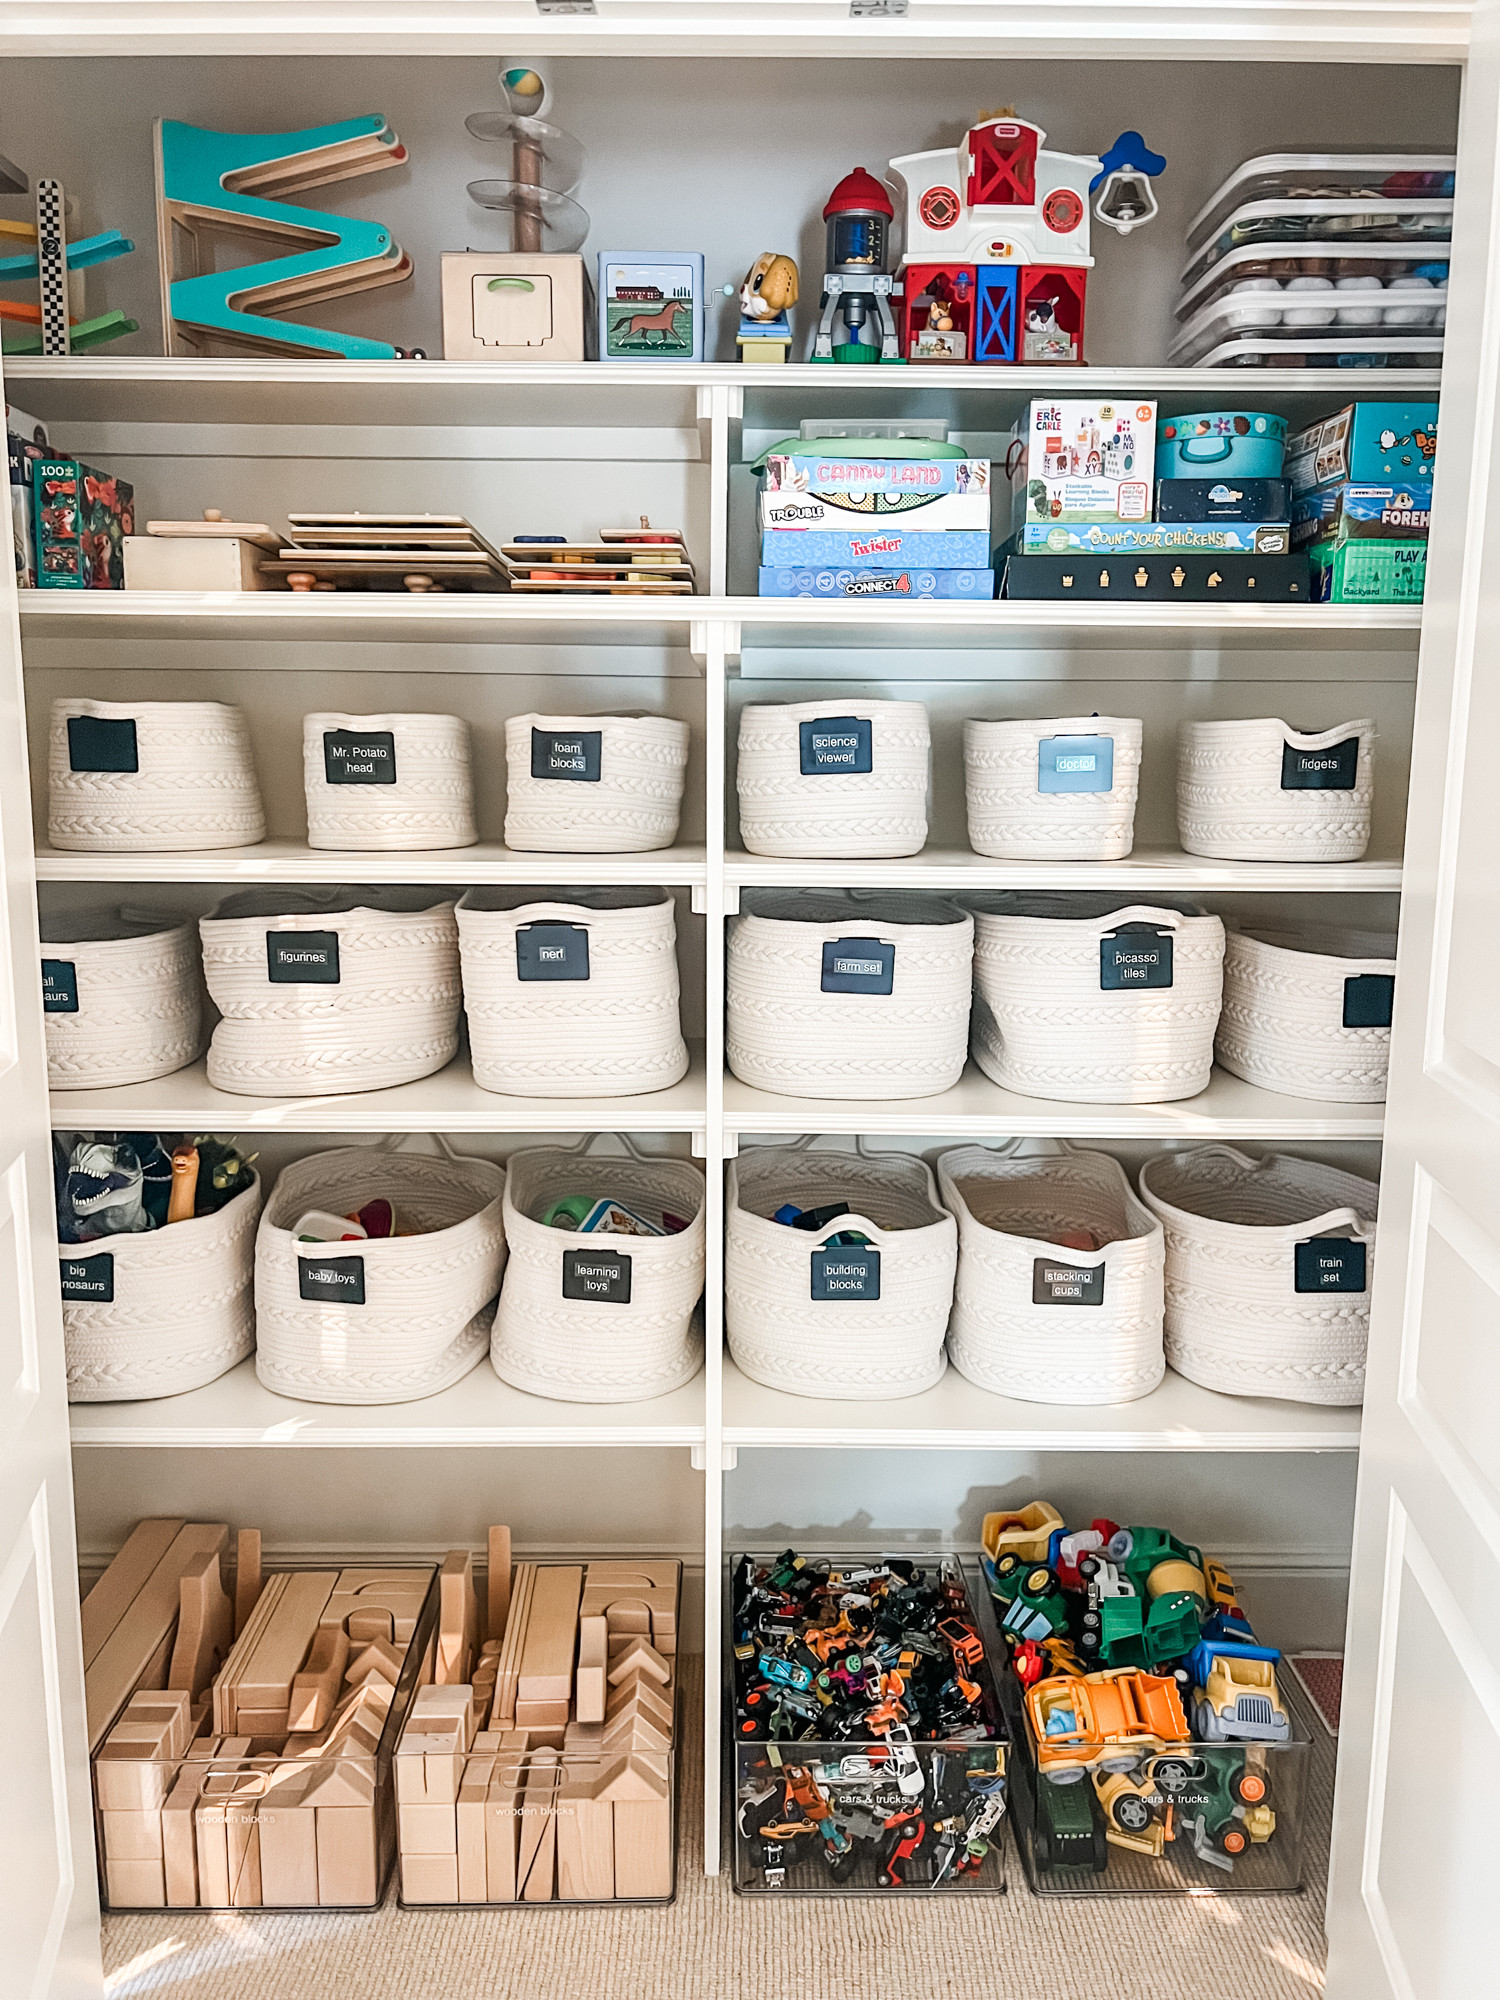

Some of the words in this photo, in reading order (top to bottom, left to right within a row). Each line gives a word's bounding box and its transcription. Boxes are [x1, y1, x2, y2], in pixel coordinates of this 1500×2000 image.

[1037, 411, 1062, 421] ERIC
[1036, 421, 1062, 431] CARLE
[41, 466, 65, 476] 100
[817, 464, 885, 482] CANDY
[891, 465, 942, 485] LAND
[769, 504, 825, 521] TROUBLE
[1090, 530, 1129, 546] COUNT
[1131, 531, 1162, 548] YOUR
[1164, 530, 1227, 547] CHICKENS!
[850, 538, 902, 556] Twister
[1394, 550, 1420, 563] PLAY
[1344, 587, 1380, 597] Backyard
[815, 735, 858, 748] science
[332, 746, 350, 758] Mr.
[352, 746, 388, 758] Potato
[554, 742, 581, 754] foam
[550, 757, 585, 769] blocks
[818, 752, 854, 763] viewer
[1059, 758, 1095, 769] doctor
[346, 762, 374, 773] head
[1301, 758, 1338, 771] fidgets
[279, 950, 326, 963] figurines
[542, 948, 564, 959] nerf
[1115, 952, 1158, 965] picasso
[836, 960, 861, 972] farm
[863, 963, 881, 973] set
[1123, 967, 1146, 979] tiles
[1319, 1256, 1343, 1268] train
[69, 1264, 87, 1277] big
[577, 1263, 618, 1279] learning
[826, 1263, 867, 1277] building
[308, 1269, 333, 1283] baby
[334, 1270, 356, 1285] toys
[1047, 1271, 1091, 1284] stacking
[1323, 1272, 1341, 1283] set
[586, 1280, 609, 1292] toys
[829, 1279, 864, 1290] blocks
[1054, 1286, 1081, 1296] cups
[839, 1795, 863, 1804] cars
[865, 1793, 873, 1804] &
[875, 1794, 909, 1804] trucks
[1141, 1795, 1164, 1804] cars
[1166, 1793, 1175, 1804] &
[1177, 1794, 1210, 1804] trucks
[495, 1805, 538, 1816] wooden
[540, 1805, 576, 1816] blocks
[196, 1814, 239, 1824] wooden
[240, 1813, 276, 1824] blocks
